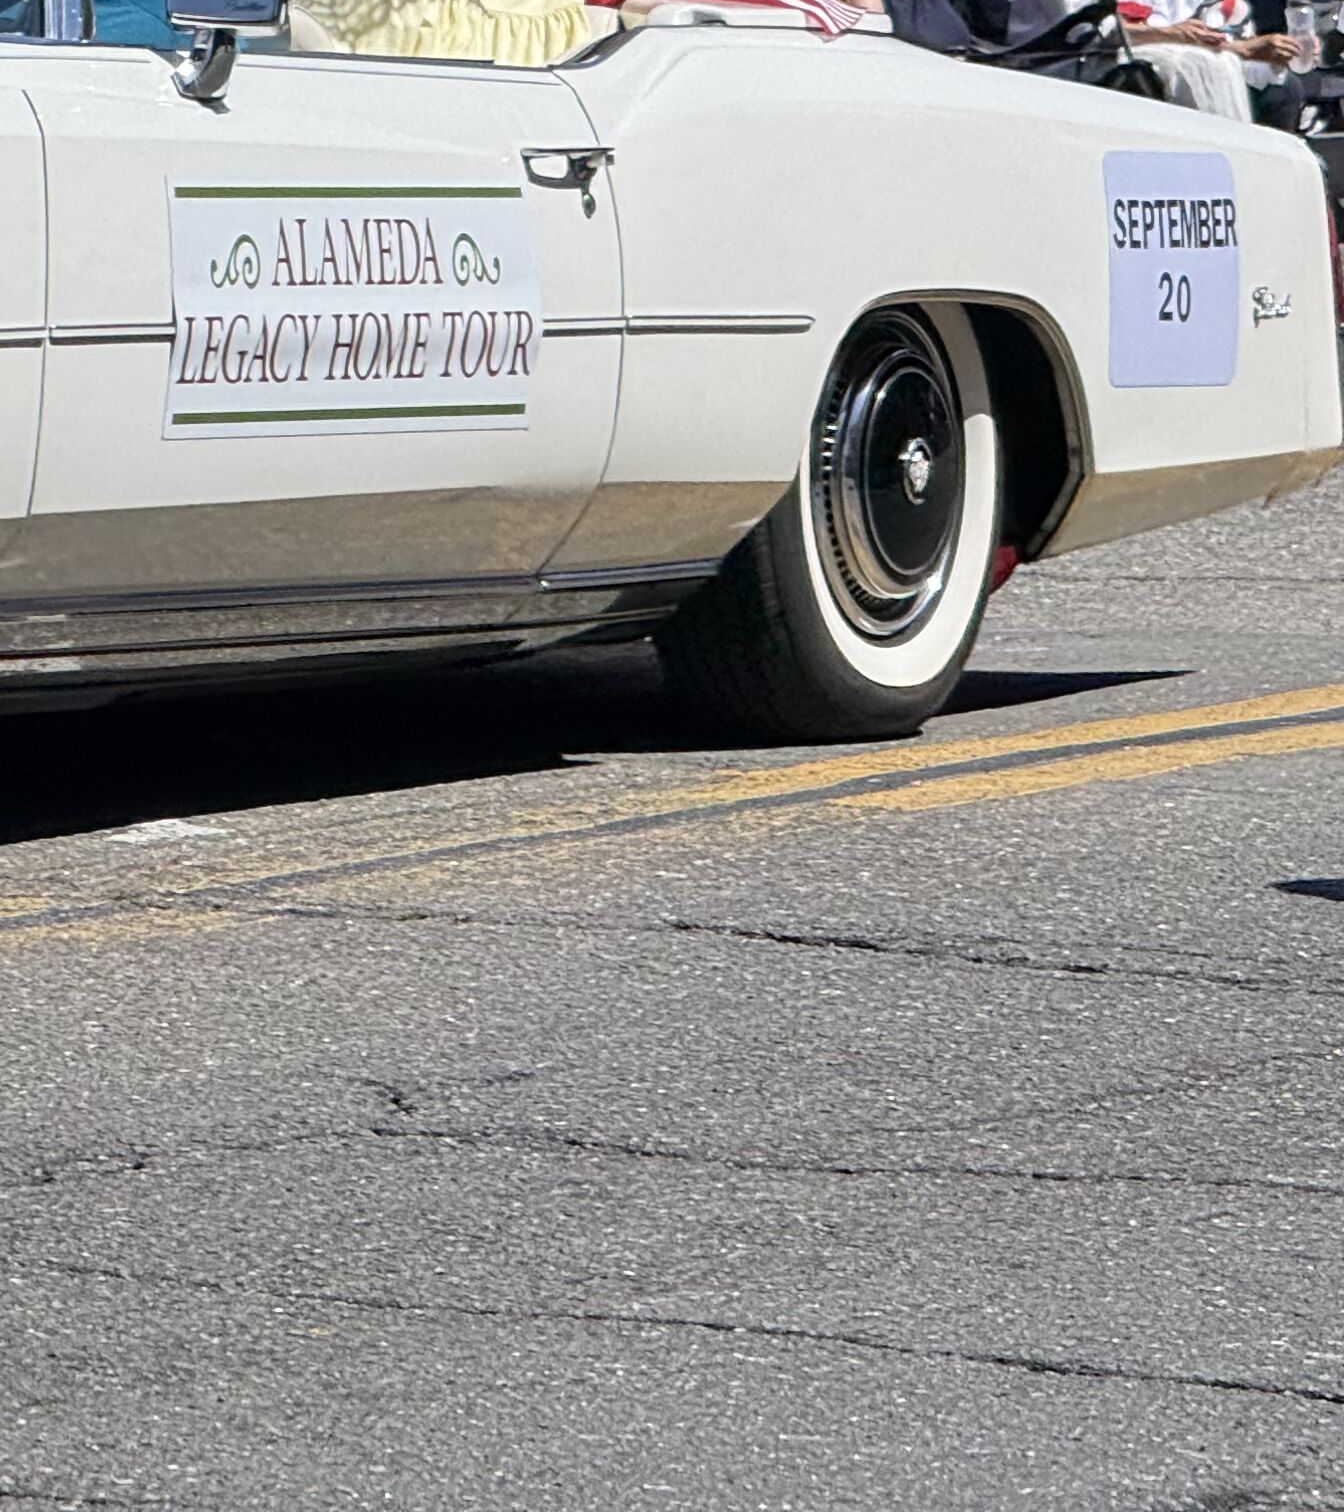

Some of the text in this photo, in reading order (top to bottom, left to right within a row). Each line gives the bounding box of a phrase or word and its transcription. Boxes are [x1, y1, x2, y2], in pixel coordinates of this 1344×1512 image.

[271, 216, 444, 287] ALAMEDA
[1112, 198, 1237, 249] SEPTEMBER
[1157, 271, 1193, 323] 20
[175, 310, 533, 385] LEGACY HOME TOUR
